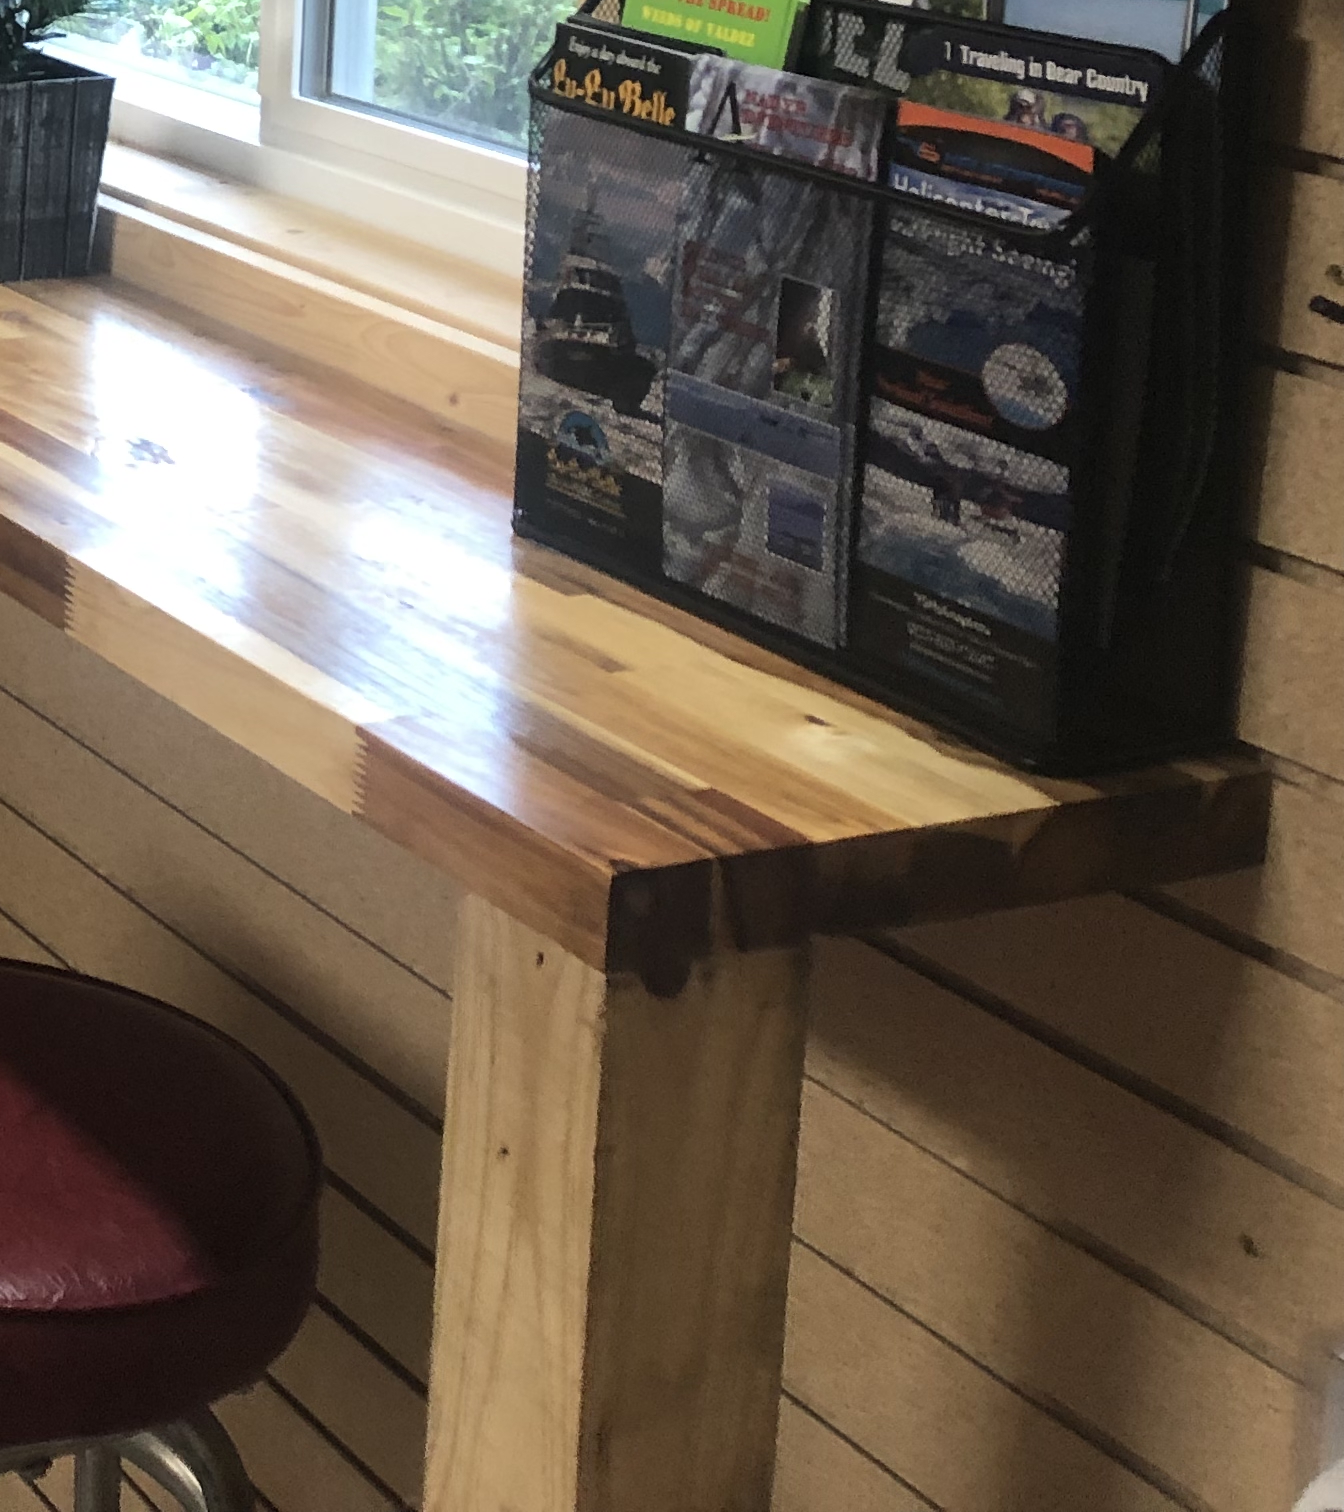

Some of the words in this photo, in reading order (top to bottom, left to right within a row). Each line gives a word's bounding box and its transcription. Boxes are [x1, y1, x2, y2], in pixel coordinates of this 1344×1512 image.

[641, 5, 683, 28] WEEDS
[685, 17, 703, 33] OF
[706, 22, 756, 48] VALDEZ
[568, 35, 591, 58] Enjoy
[599, 44, 615, 66] day
[616, 50, 646, 72] aboard
[647, 56, 662, 75] the
[960, 44, 1025, 80] Traveling
[1029, 56, 1042, 77] in
[1045, 61, 1082, 85] Bear
[1086, 68, 1149, 102] Country
[618, 79, 676, 127] Belle
